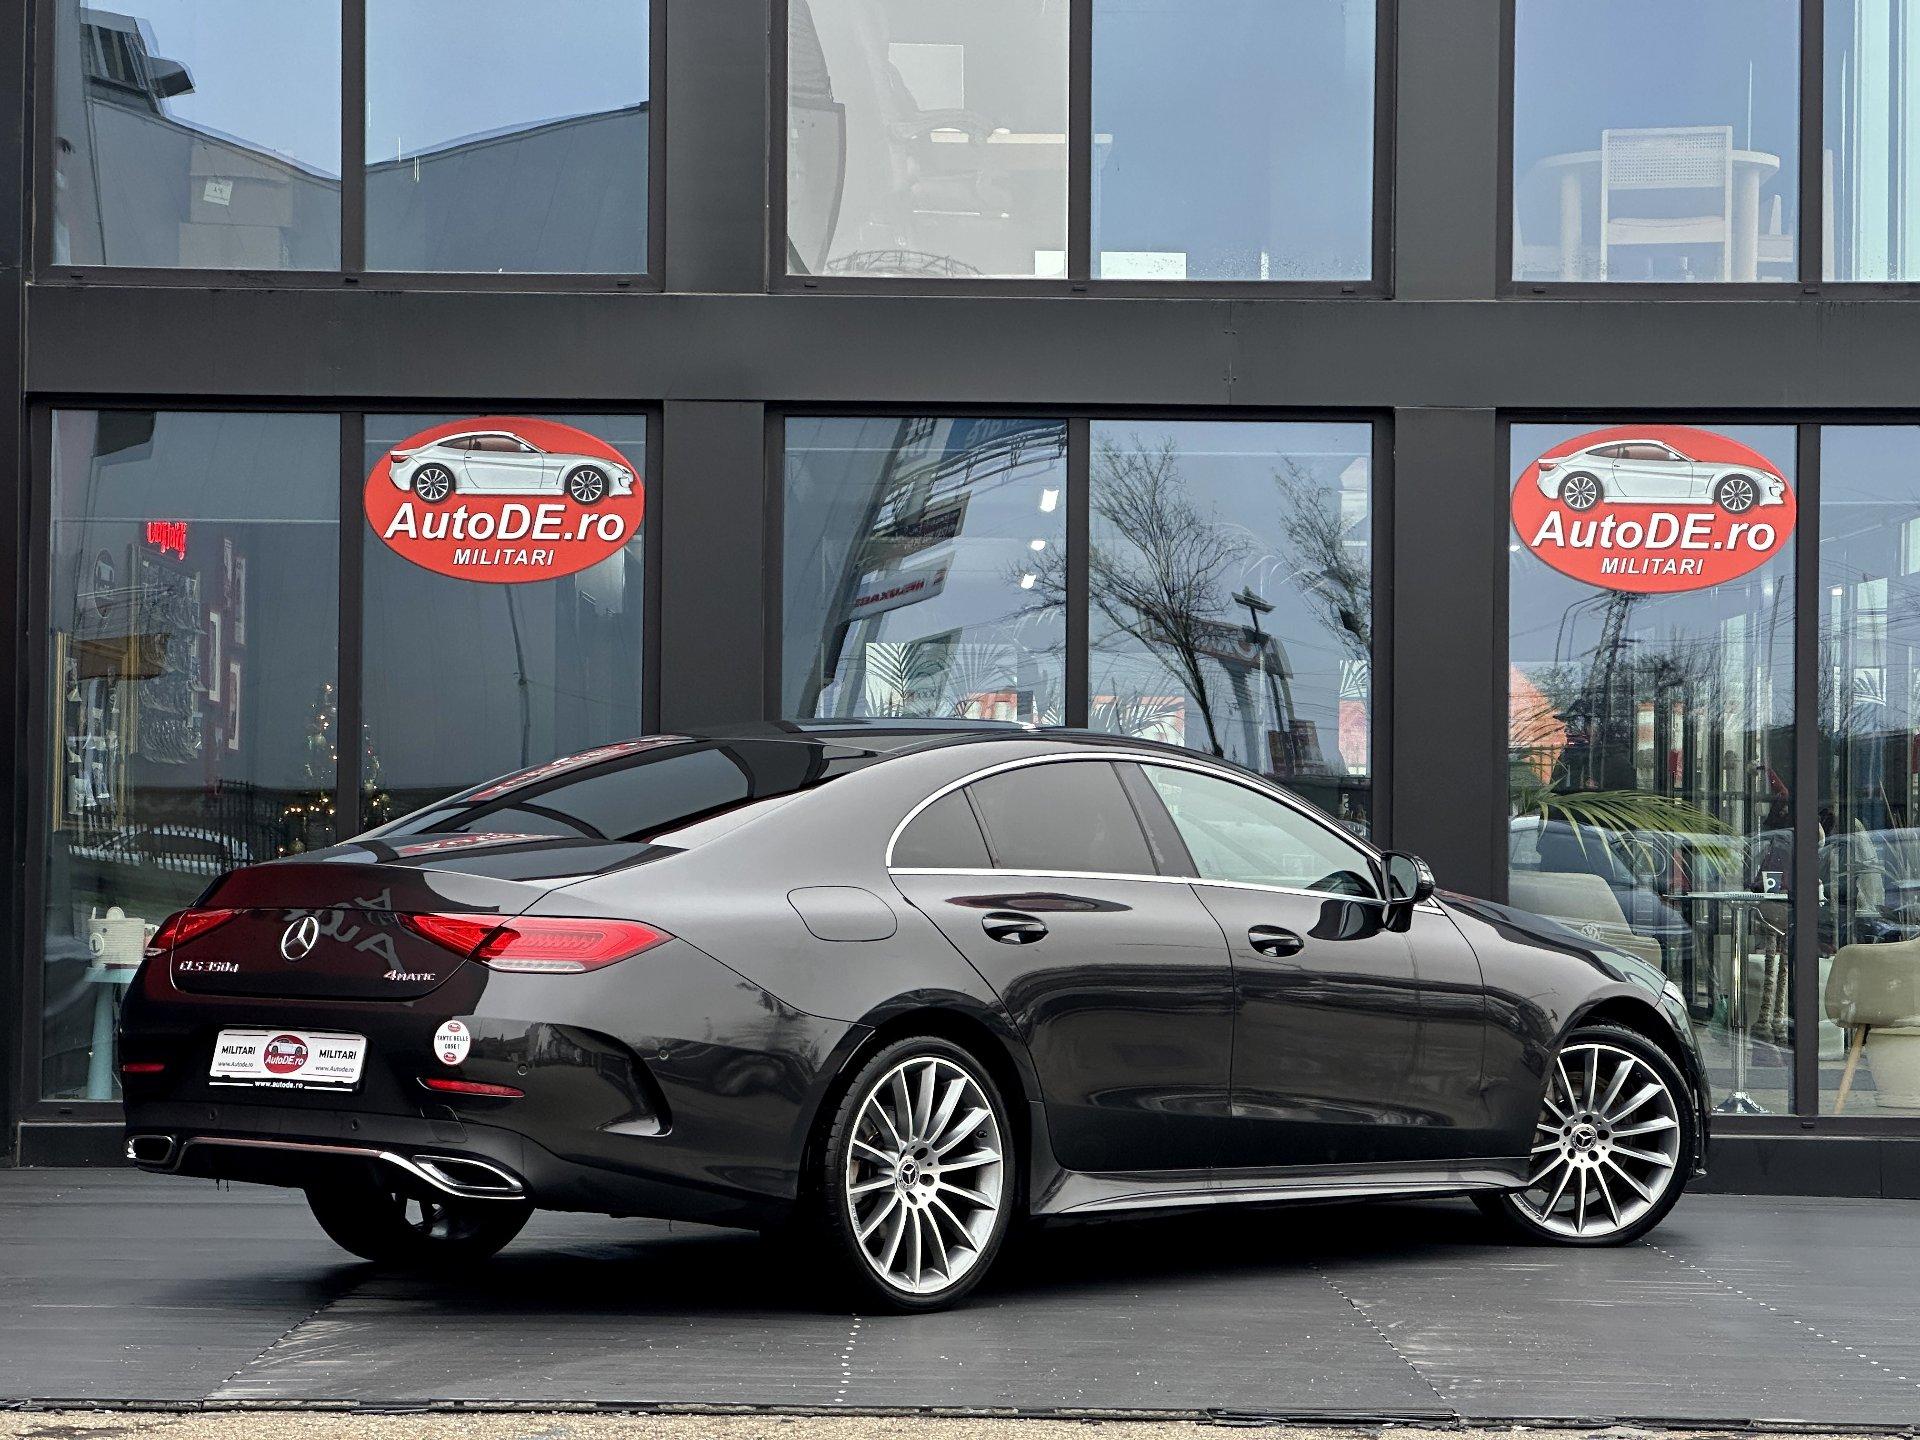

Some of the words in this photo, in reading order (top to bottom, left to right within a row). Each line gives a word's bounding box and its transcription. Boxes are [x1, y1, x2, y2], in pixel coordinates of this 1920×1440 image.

[383, 502, 625, 542] AutoDE.ro
[1531, 510, 1776, 551] AutoDE.ro
[453, 548, 555, 566] MILITARI
[1601, 557, 1704, 575] MILITARI
[180, 960, 204, 972] CLS
[204, 961, 239, 973] 350d
[383, 969, 436, 981] 4MATIC
[221, 1045, 256, 1055] MILITARI
[318, 1049, 357, 1060] MILITARI
[265, 1054, 304, 1066] AutoDE.ro
[315, 1065, 355, 1073] www.Autode.ro
[254, 1080, 304, 1089] www.autode.ro
